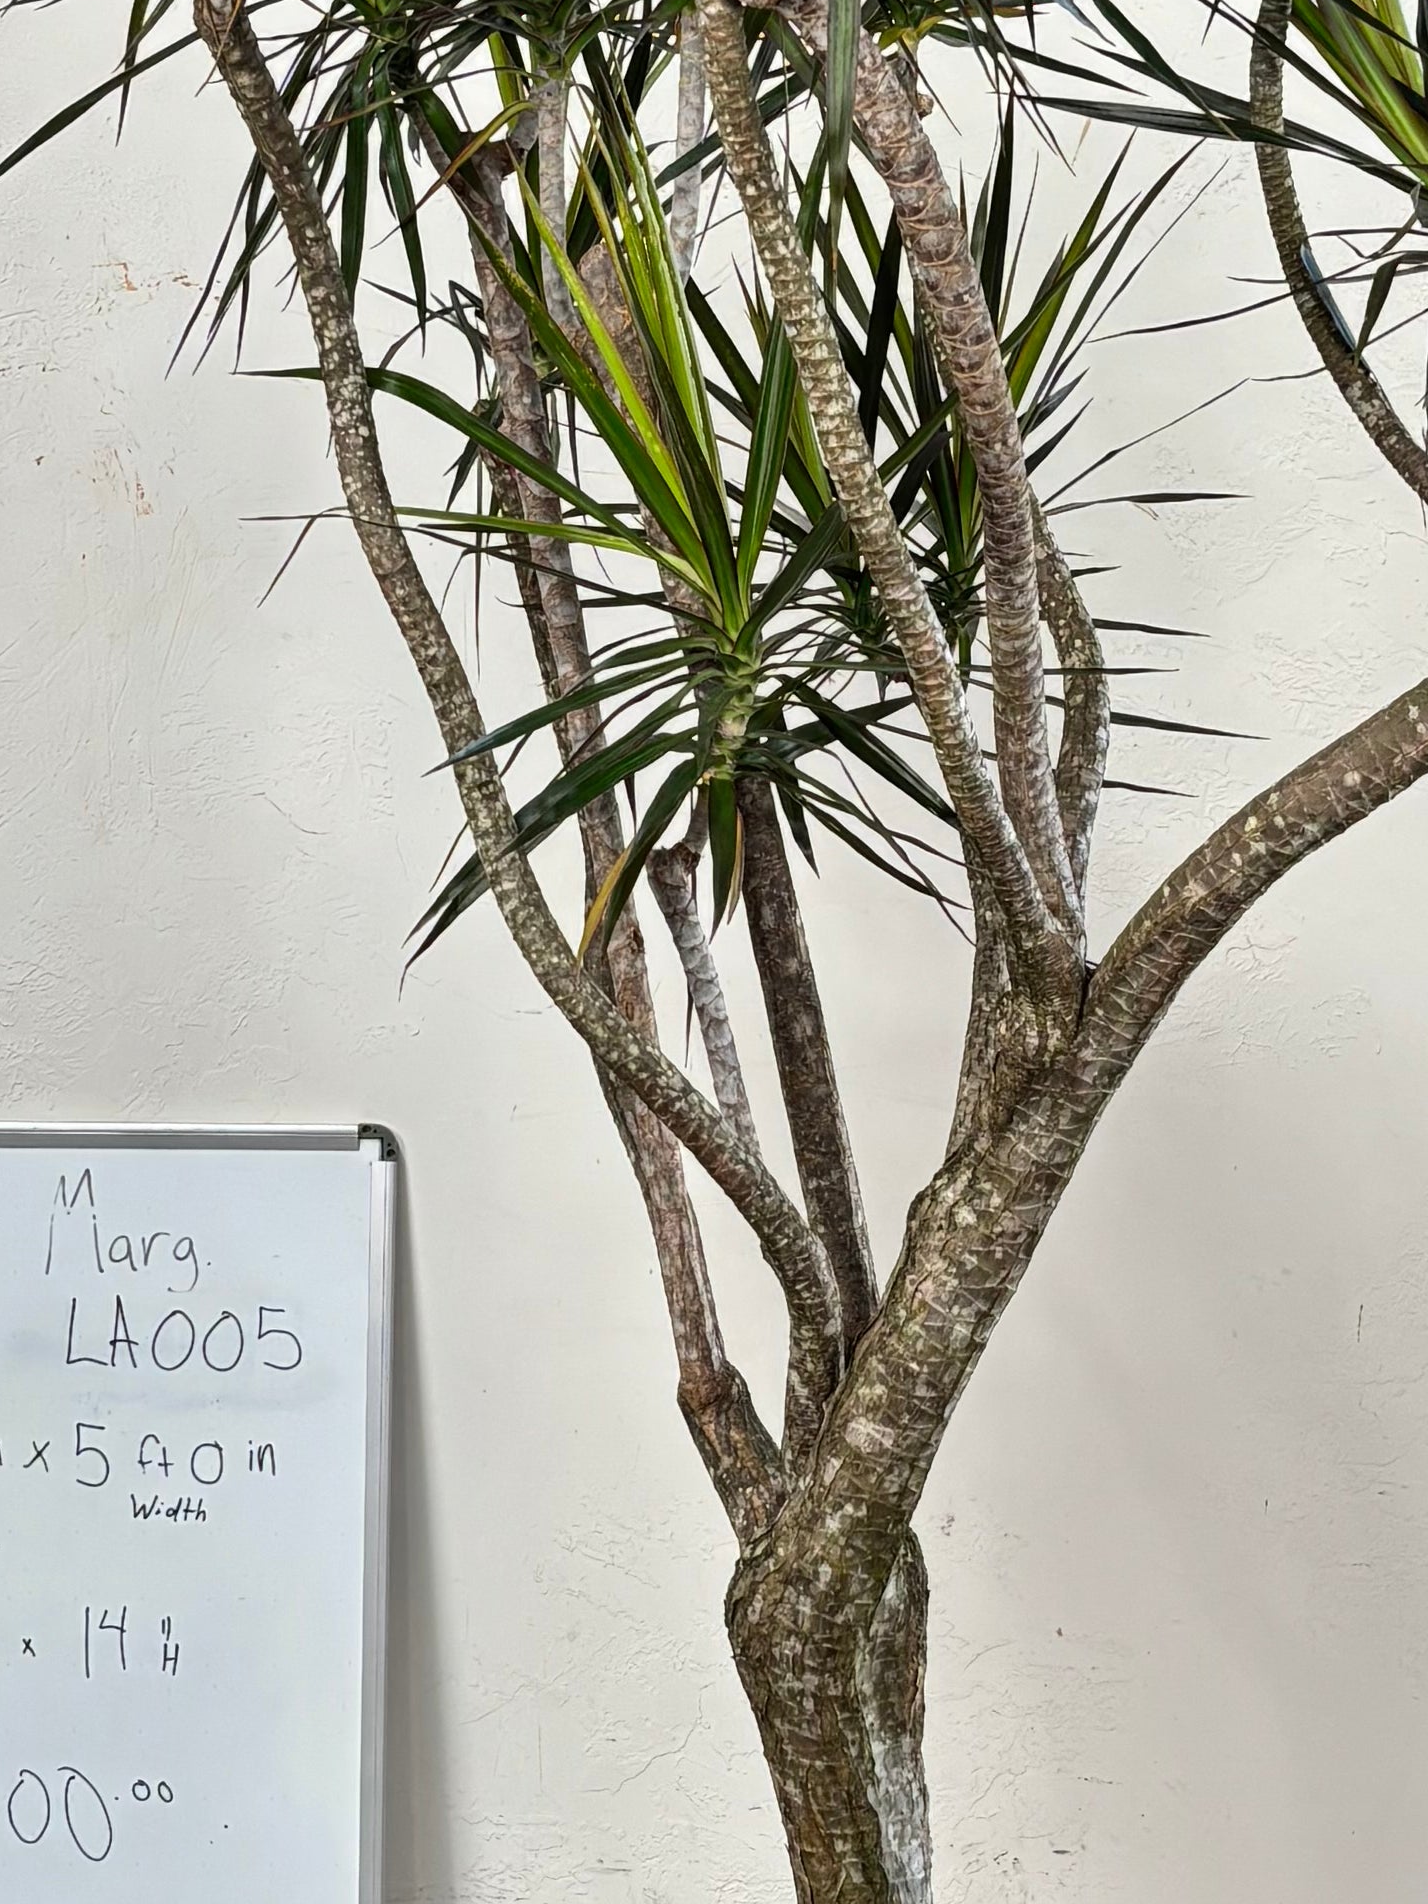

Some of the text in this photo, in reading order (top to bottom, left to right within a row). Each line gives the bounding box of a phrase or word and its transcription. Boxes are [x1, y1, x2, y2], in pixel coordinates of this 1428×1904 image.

[44, 1167, 212, 1293] Marg.
[65, 1294, 303, 1372] LA005
[131, 1493, 208, 1523] Width
